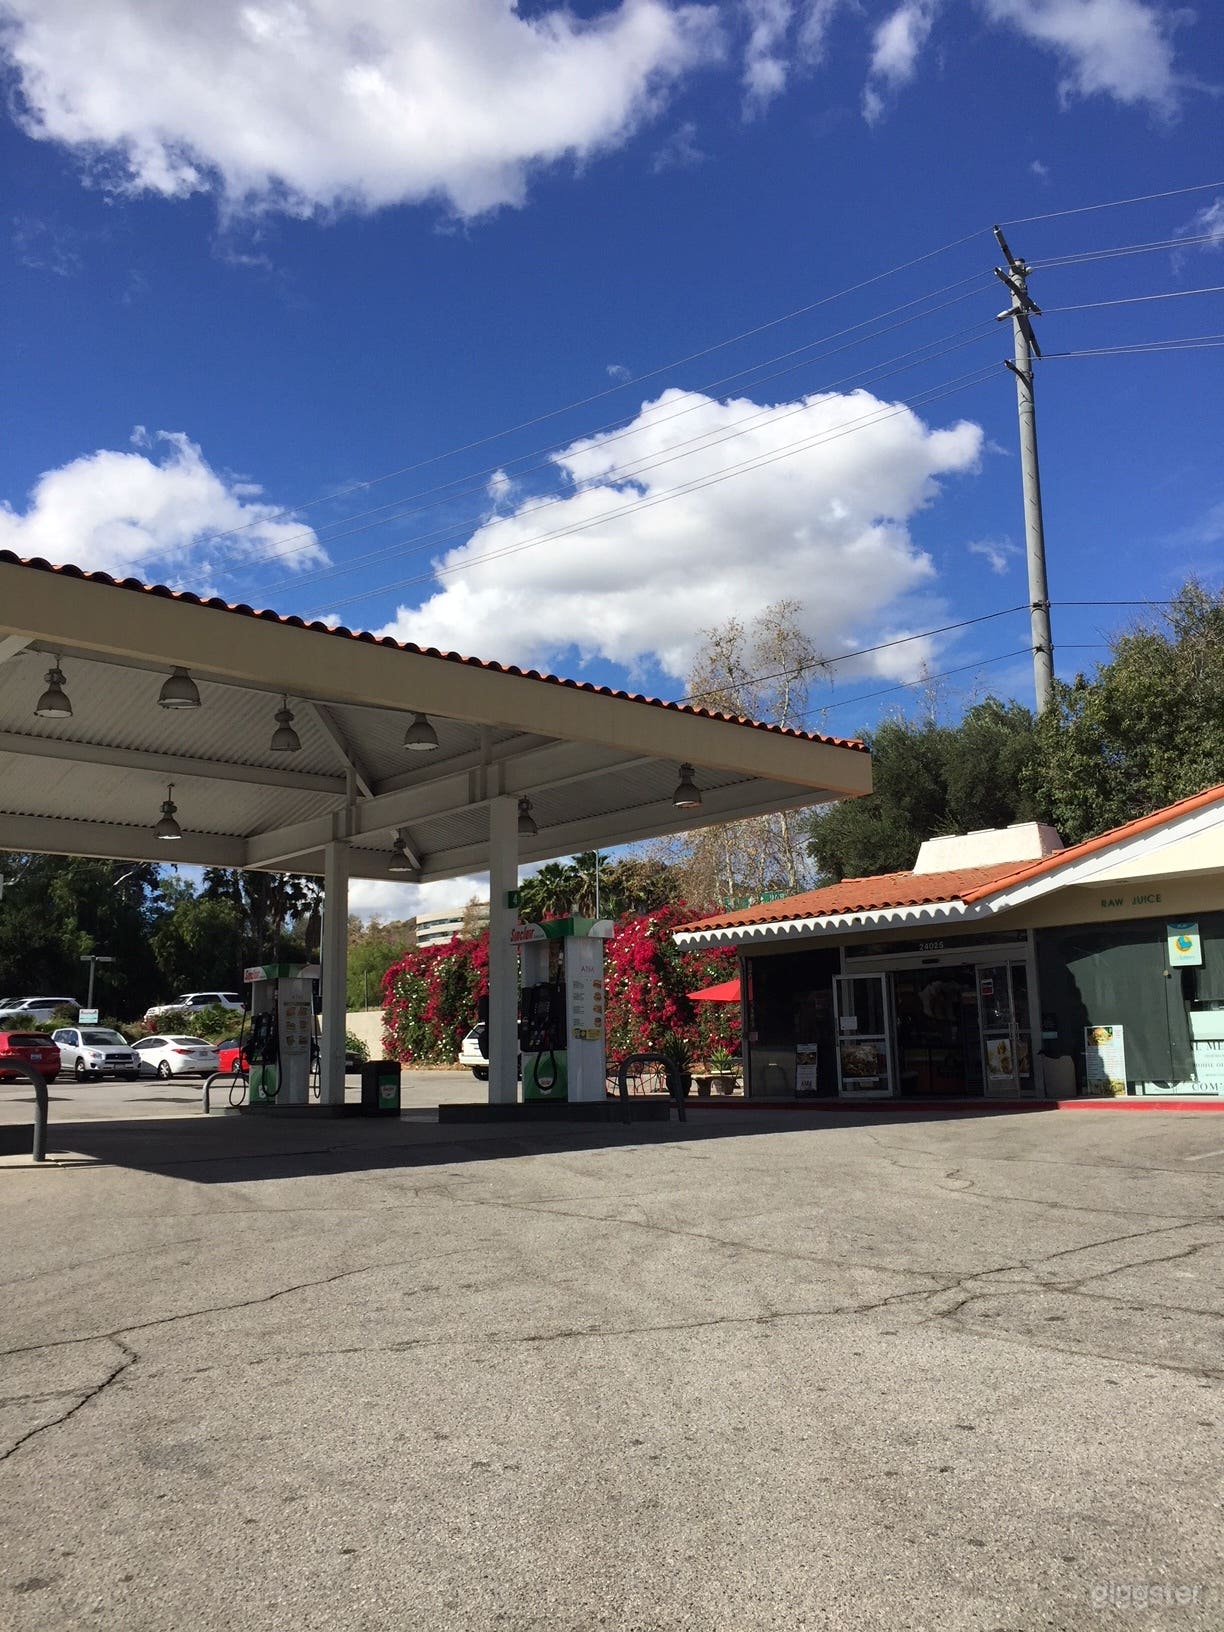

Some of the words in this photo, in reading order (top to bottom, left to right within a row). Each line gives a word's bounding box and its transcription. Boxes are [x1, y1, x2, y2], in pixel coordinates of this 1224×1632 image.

[512, 894, 518, 905] 4
[1101, 897, 1124, 908] RAW
[1131, 893, 1161, 905] JUICE
